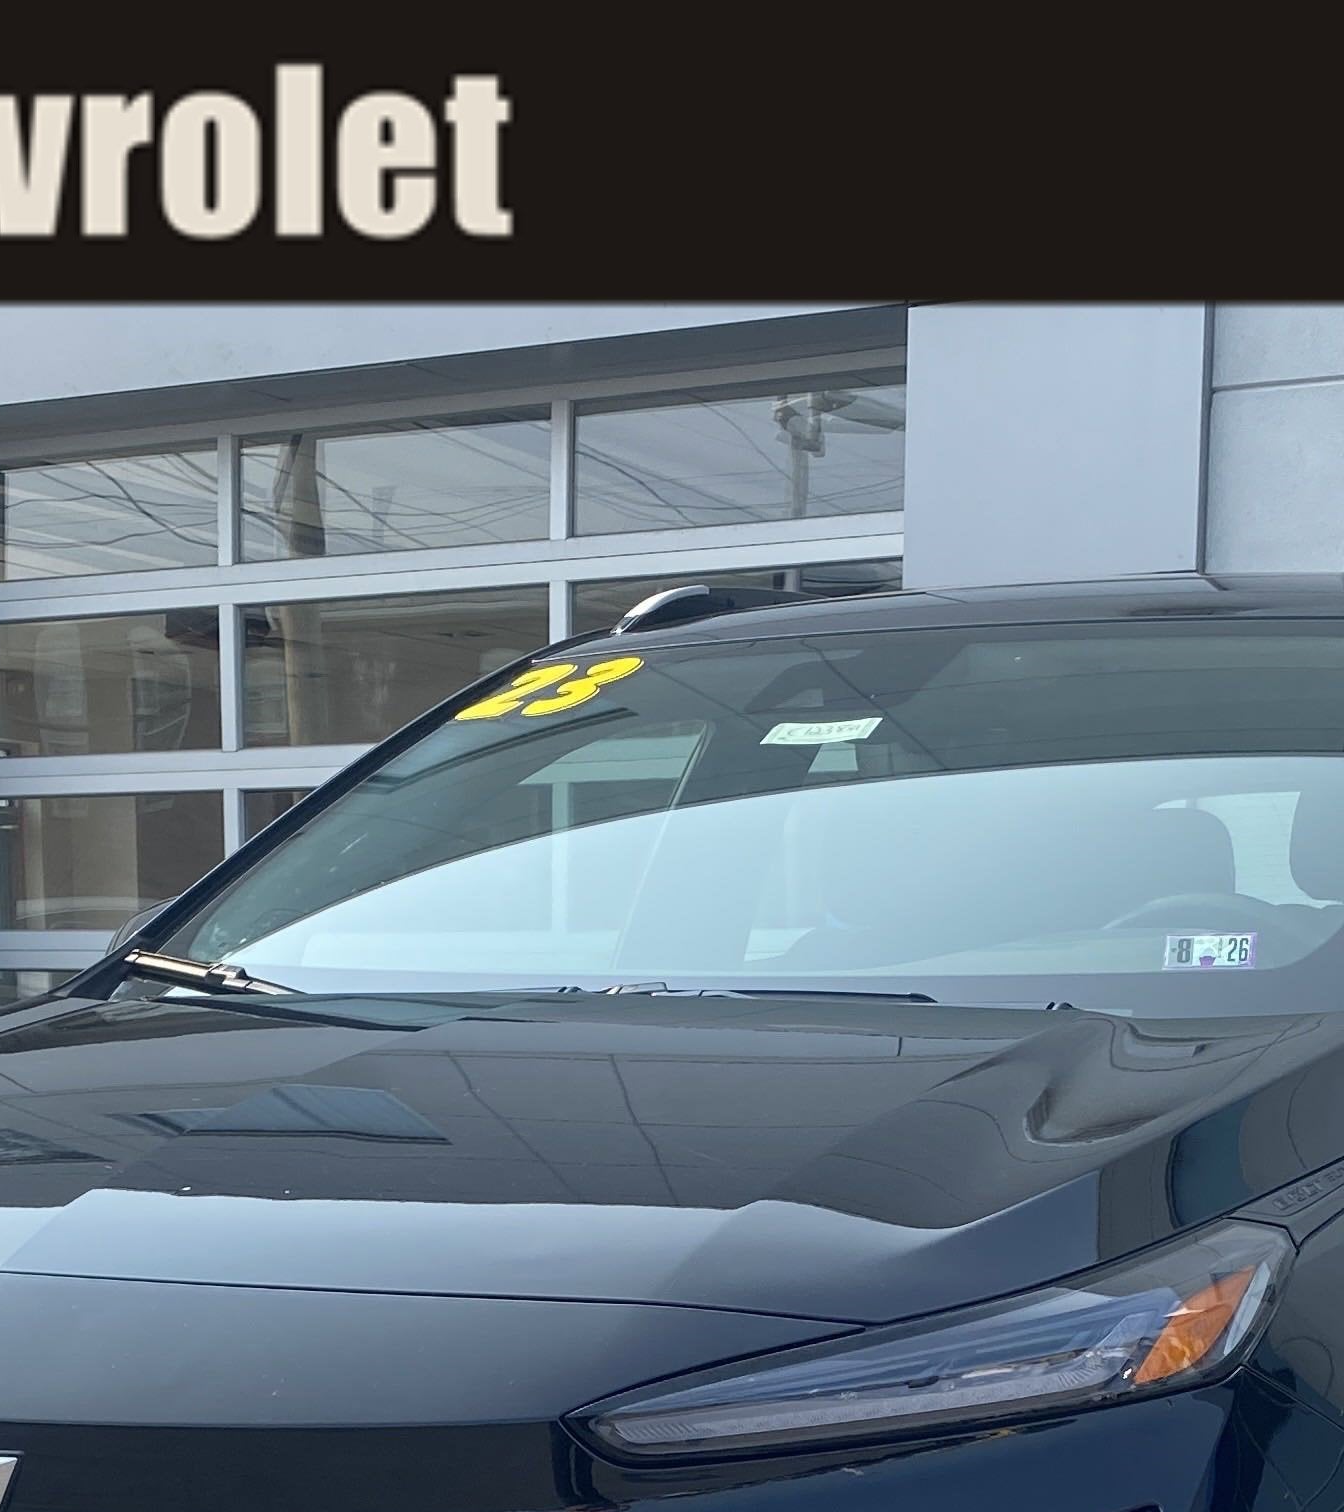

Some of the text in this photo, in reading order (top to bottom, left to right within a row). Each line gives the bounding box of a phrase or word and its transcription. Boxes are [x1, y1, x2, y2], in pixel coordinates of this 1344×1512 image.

[455, 656, 645, 721] 23
[1176, 937, 1192, 964] 8
[1226, 937, 1250, 962] 26
